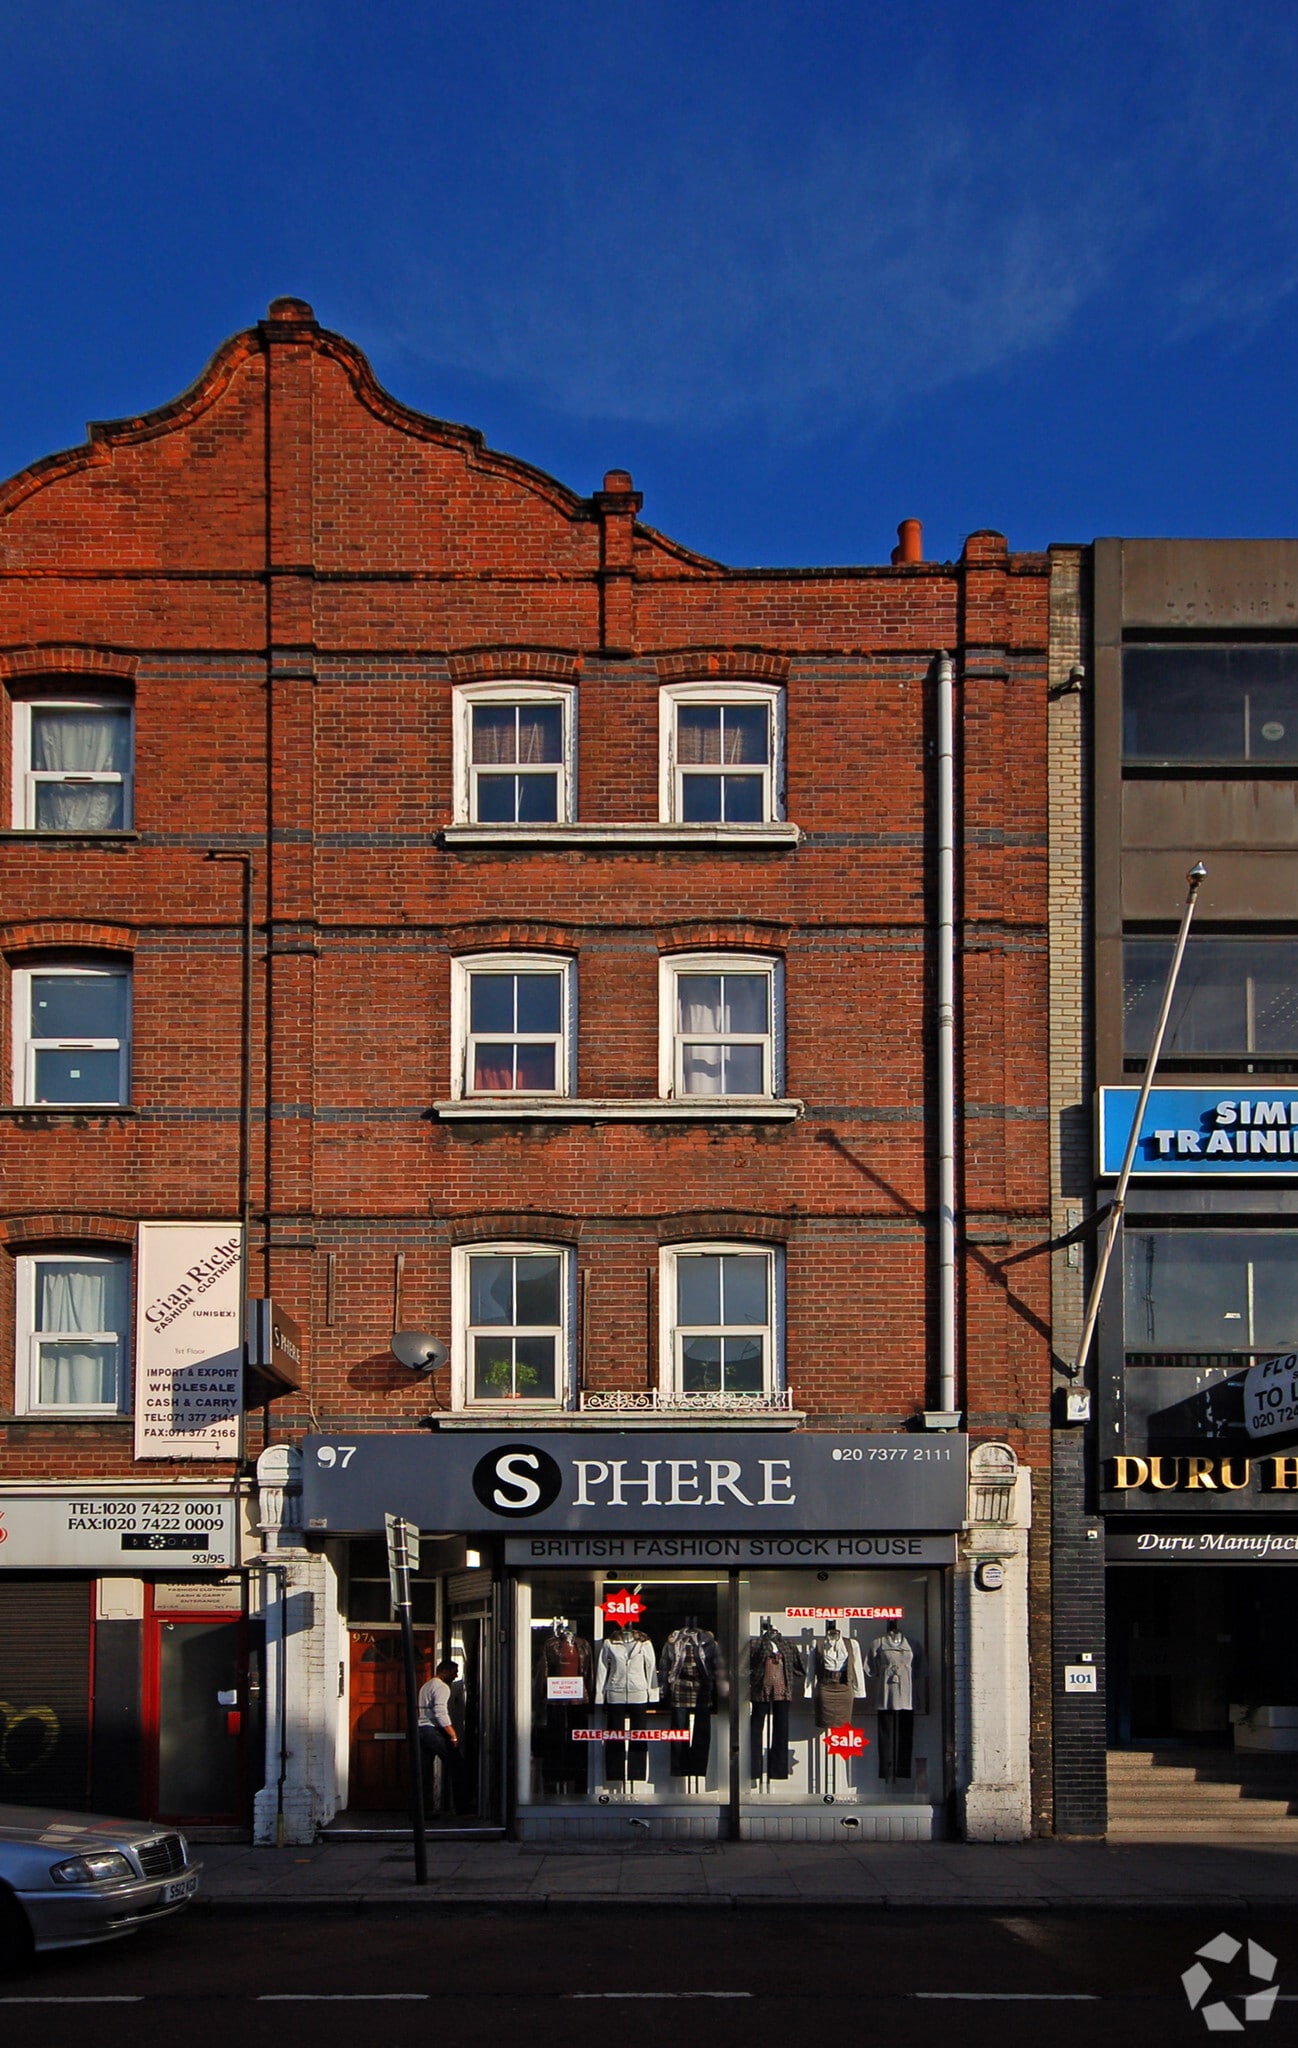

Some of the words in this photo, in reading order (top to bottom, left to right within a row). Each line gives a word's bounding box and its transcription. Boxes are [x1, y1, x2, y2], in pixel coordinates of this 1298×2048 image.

[145, 1283, 192, 1324] Gian
[186, 1238, 242, 1283] Riche
[154, 1296, 195, 1334] FASHION
[198, 1254, 242, 1293] CLOTHING
[147, 1368, 184, 1377] IMPORT
[188, 1368, 194, 1377] &
[198, 1368, 239, 1377] EXPORT
[150, 1383, 235, 1392] WHOLESALE
[147, 1398, 179, 1407] CASH
[184, 1399, 190, 1407] &
[196, 1398, 238, 1407] CARRY
[1254, 1387, 1283, 1410] TO
[144, 1414, 184, 1422] TEL:071
[188, 1414, 206, 1422] 377
[211, 1414, 235, 1422] 2144
[1252, 1412, 1274, 1429] 020
[144, 1429, 186, 1437] FAX:071
[189, 1429, 206, 1437] 377
[211, 1429, 236, 1437] 2166
[317, 1446, 357, 1468] 97
[832, 1449, 862, 1461] 020
[868, 1449, 908, 1461] 7377
[913, 1449, 950, 1461] 2111
[1112, 1456, 1250, 1489] DURU
[142, 1503, 180, 1515] 7422
[184, 1503, 222, 1515] 0001
[142, 1519, 180, 1530] 7422
[184, 1519, 224, 1531] 0009
[531, 1540, 624, 1555] BRITISH
[634, 1540, 740, 1555] FASHION
[750, 1540, 830, 1555] STOCK
[838, 1540, 922, 1554] HOUSE
[1137, 1534, 1195, 1550] Duru
[192, 1554, 225, 1564] 93/95
[607, 1597, 639, 1613] sale
[787, 1609, 814, 1617] SALE
[816, 1609, 843, 1617] SALE
[845, 1609, 872, 1617] SALE
[874, 1609, 902, 1617] SALE
[1070, 1674, 1092, 1684] 101
[573, 1731, 601, 1740] SALE
[602, 1731, 630, 1740] SALE
[631, 1731, 659, 1740] SALE
[661, 1731, 689, 1740] SALE
[830, 1730, 862, 1747] sale
